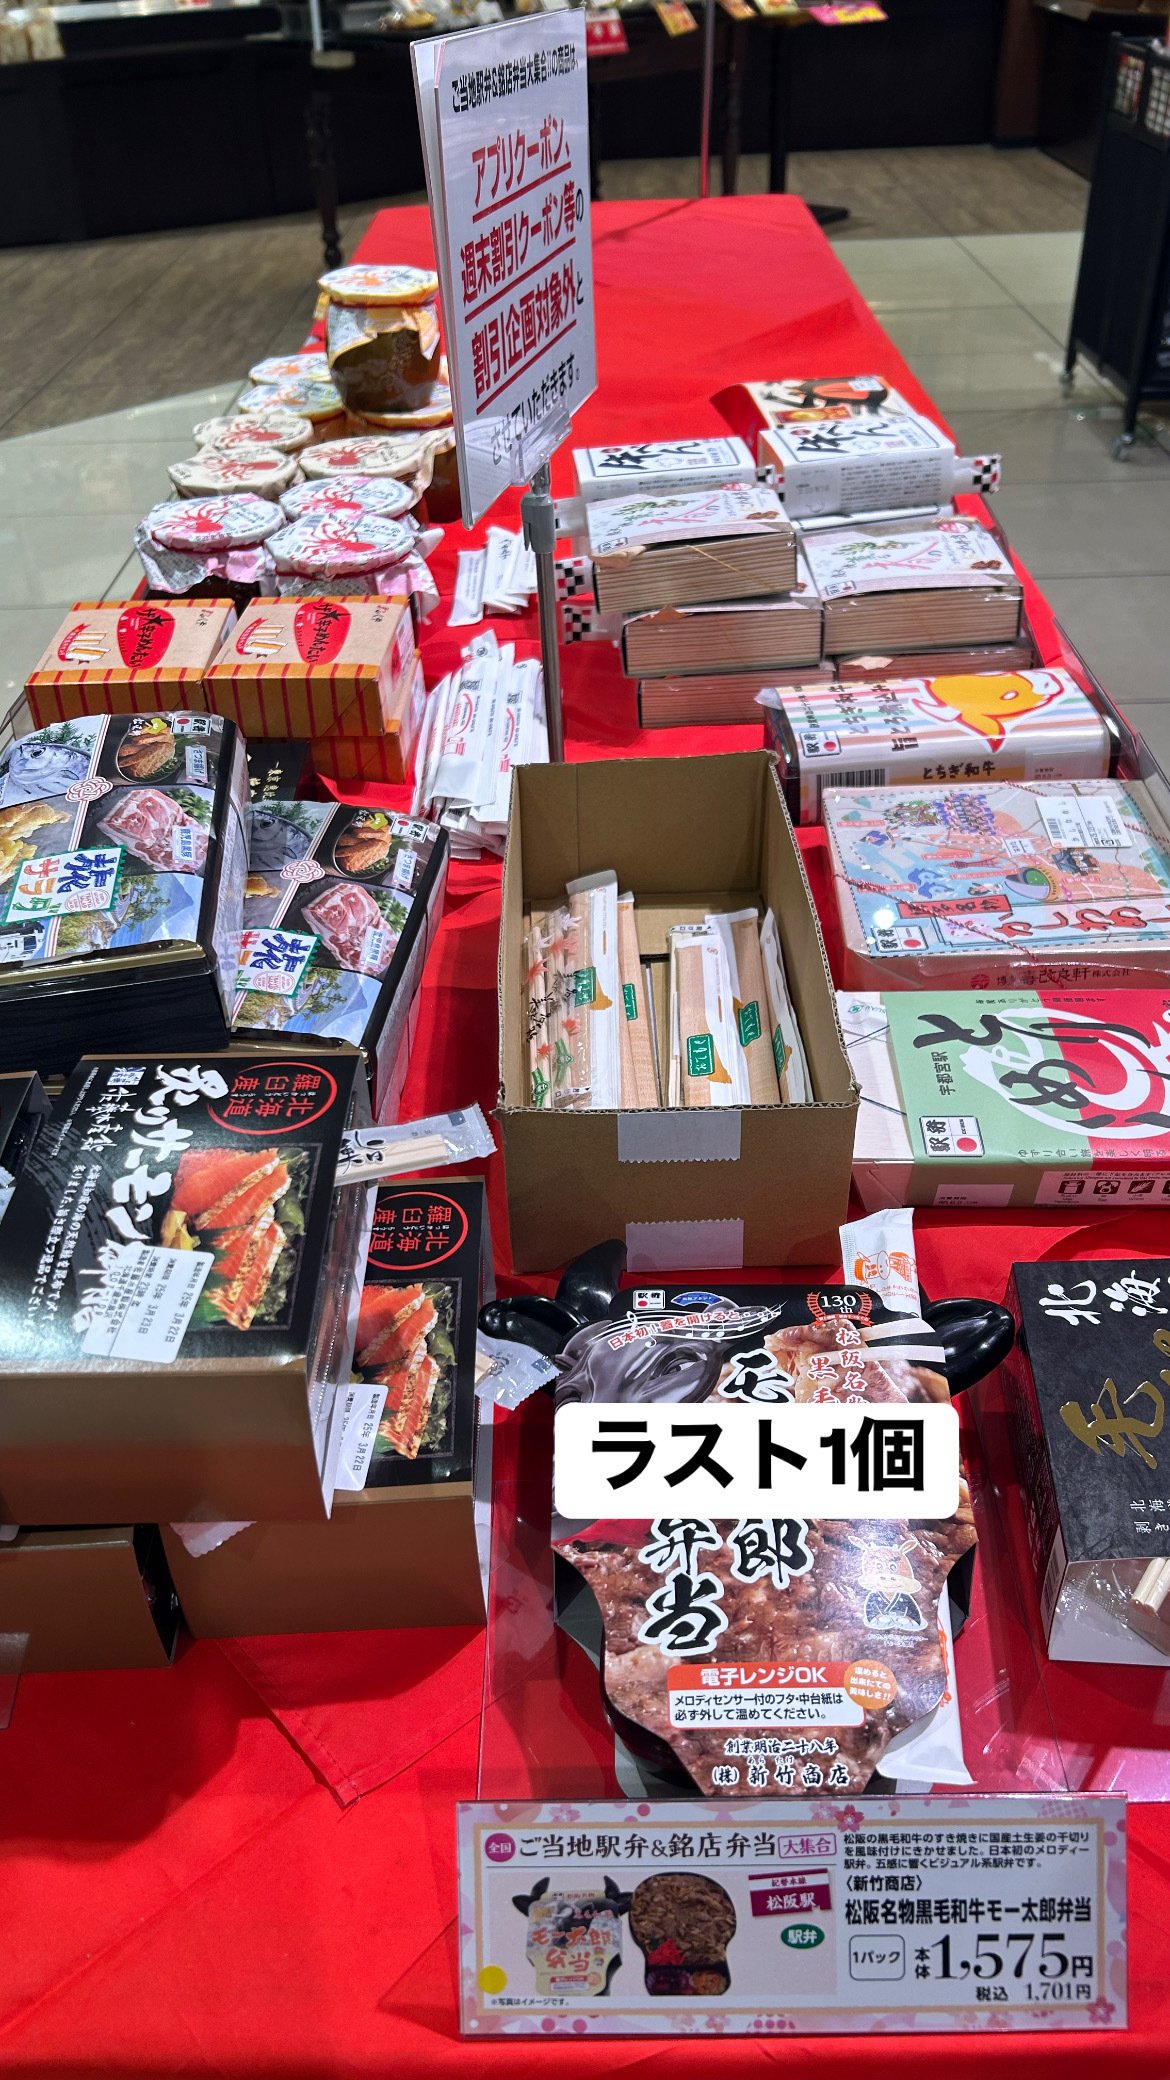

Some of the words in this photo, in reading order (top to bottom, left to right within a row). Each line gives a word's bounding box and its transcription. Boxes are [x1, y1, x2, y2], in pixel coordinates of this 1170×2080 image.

[471, 114, 571, 208] アプリクーポン、
[460, 180, 584, 307] 週末割引クーポン等の
[471, 258, 584, 400] 割引企画対象外と
[922, 760, 997, 780] とちぎ和牛
[11, 858, 62, 917] サラダ
[911, 897, 1004, 916] 博多名物
[877, 926, 901, 951] 駅弁
[232, 1072, 322, 1093] 羅臼産
[931, 1050, 956, 1097] 宇都宮駅
[222, 1097, 316, 1118] 北海道
[926, 1118, 952, 1153] 駅弁
[374, 1204, 453, 1225] 羅臼産
[368, 1230, 451, 1254] 北海道
[636, 1291, 662, 1301] 駅弁
[820, 1294, 857, 1308] 130
[839, 1305, 854, 1314] th
[1038, 1270, 1170, 1326] 北海
[136, 1303, 158, 1337] 3月23日
[164, 1310, 187, 1345] 3月22日
[351, 1441, 369, 1472] 3月22日
[700, 1667, 827, 1687] 電子レンジOK
[850, 1676, 892, 1690] 出来たての
[674, 1692, 844, 1707] メロディセンサー付のフタ・中台紙は
[849, 1686, 892, 1701] 美味しさ!!
[674, 1707, 828, 1722] 必ず外して温めてください。
[724, 1738, 839, 1756] 創業明治二十八年
[485, 1841, 513, 1855] 全国
[518, 1832, 777, 1859] ご当地駅弁&銘店弁当
[783, 1837, 833, 1855] 大集合
[843, 1831, 1090, 1845] 松阪の黒毛和牛のすき焼きに国産土生姜の千切り
[843, 1844, 1090, 1857] を風味付けにきかせました。日本初のメロディー
[843, 1857, 1043, 1870] 駅弁。五感に響くビジュアル系駅弁です。
[770, 1875, 808, 1887] 紀勢本線
[845, 1874, 924, 1893] 〈新竹商店〉
[765, 1891, 818, 1911] 松阪駅
[844, 1896, 1093, 1925] 松阪名物黒毛和牛モー太郎弁当
[787, 1928, 818, 1944] 駅弁
[545, 1947, 591, 1972] 弁当
[852, 1951, 901, 1965] 1パック
[914, 1947, 932, 1980] 本体
[931, 1932, 1094, 1981] 1,575円
[975, 1986, 1009, 2002] 税込
[1024, 1982, 1092, 2001] 1,701円
[490, 1997, 571, 2008] ※写真はイメージです。
